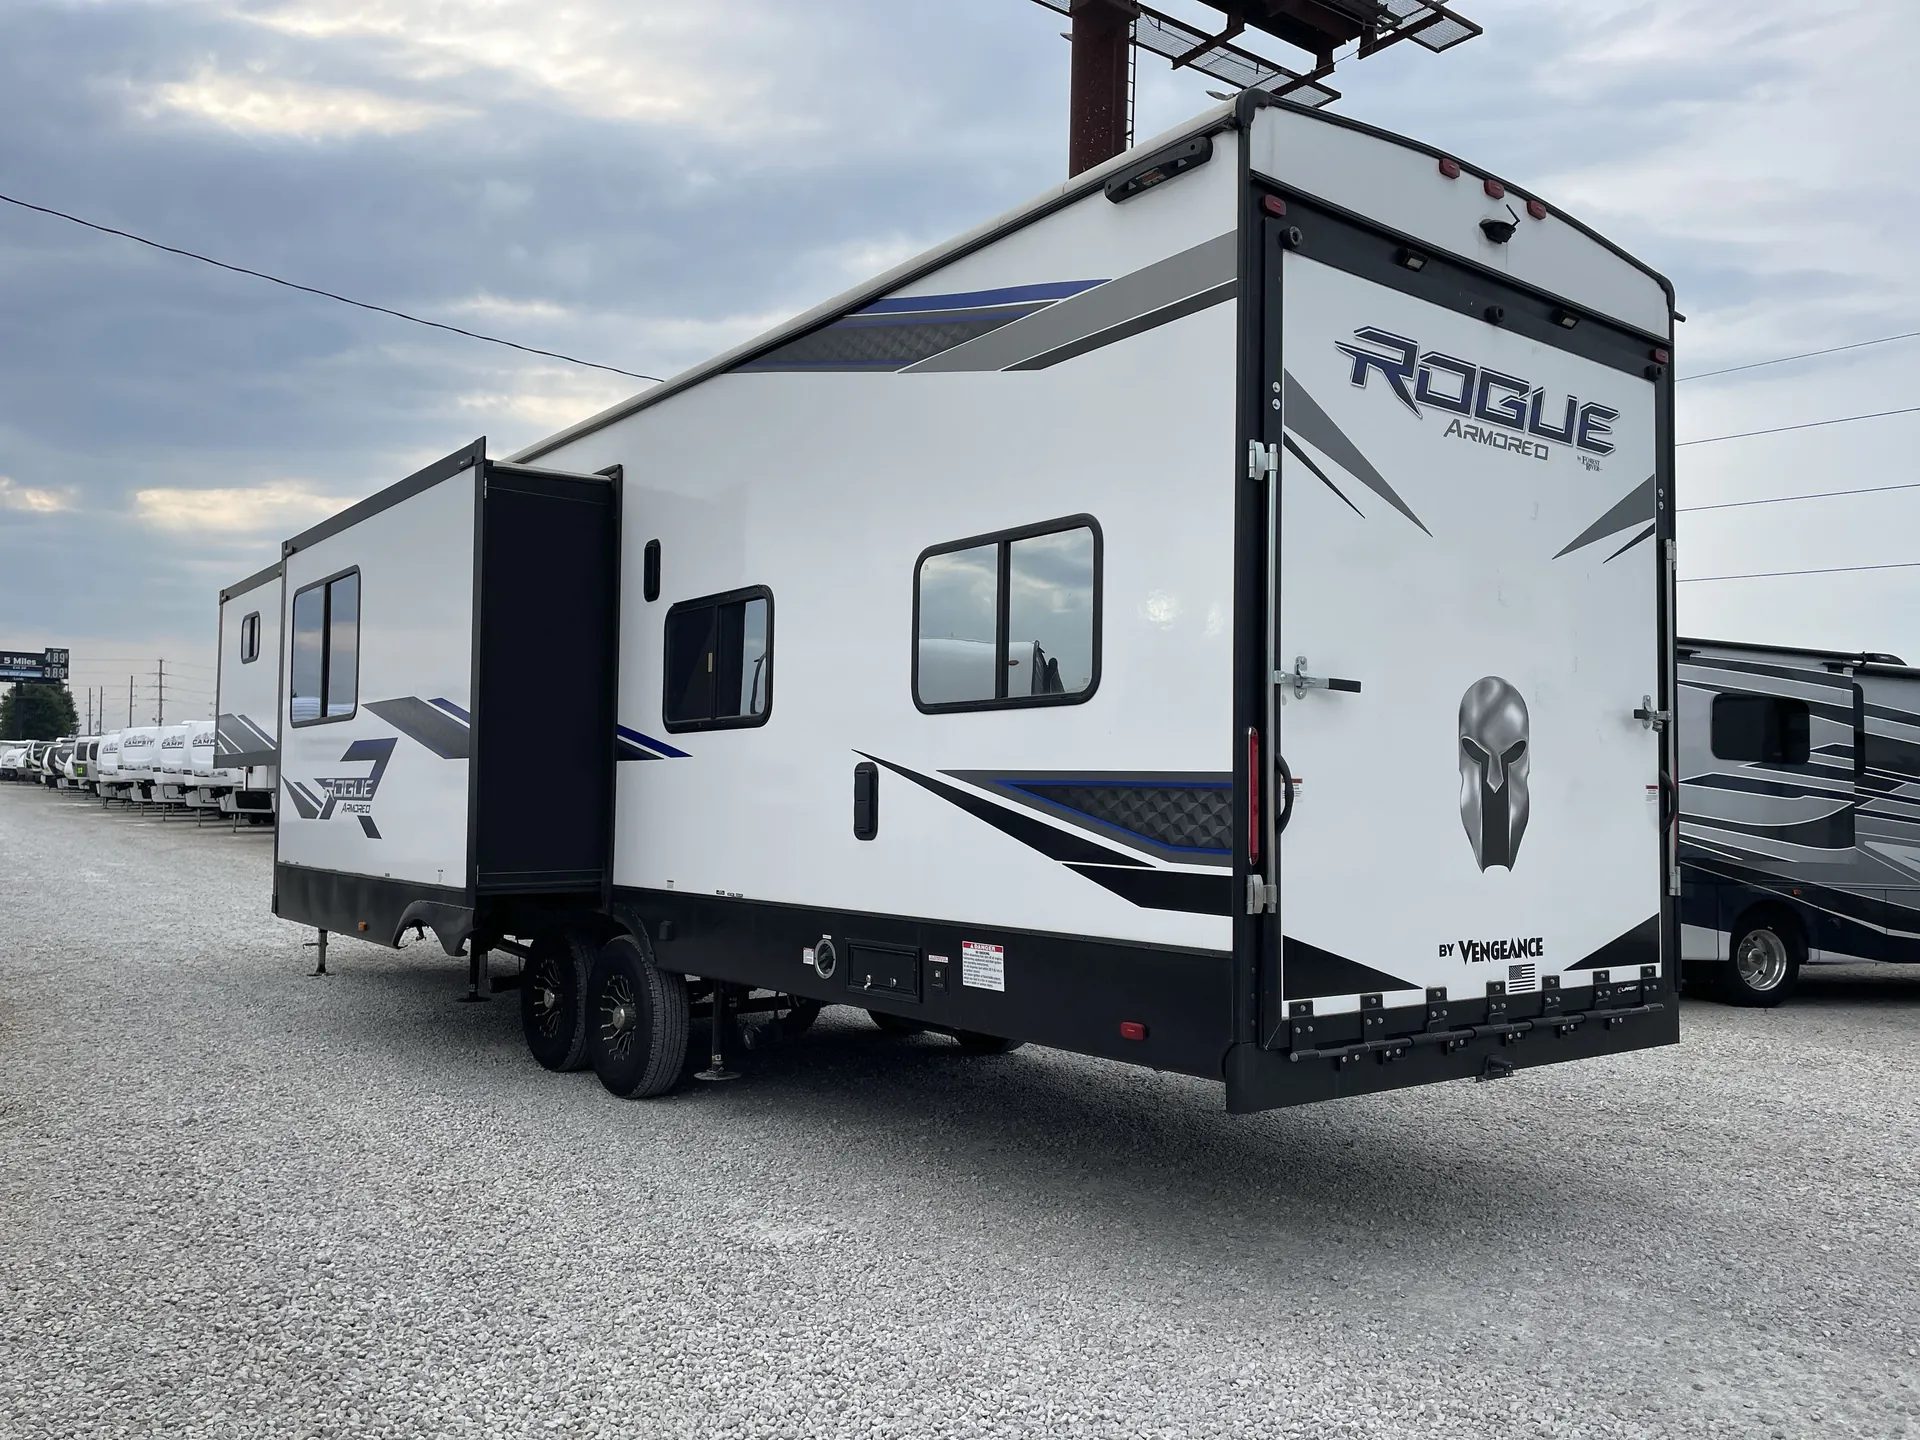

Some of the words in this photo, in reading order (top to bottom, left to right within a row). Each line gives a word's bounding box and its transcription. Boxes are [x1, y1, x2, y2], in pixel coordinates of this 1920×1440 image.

[1334, 325, 1621, 456] ROGUE
[1443, 418, 1549, 461] ARMORED
[3, 656, 11, 664] 5
[13, 657, 37, 666] Miles
[323, 778, 374, 801] ROGUE
[1438, 943, 1455, 958] BY
[1457, 936, 1544, 966] VENGEANCE
